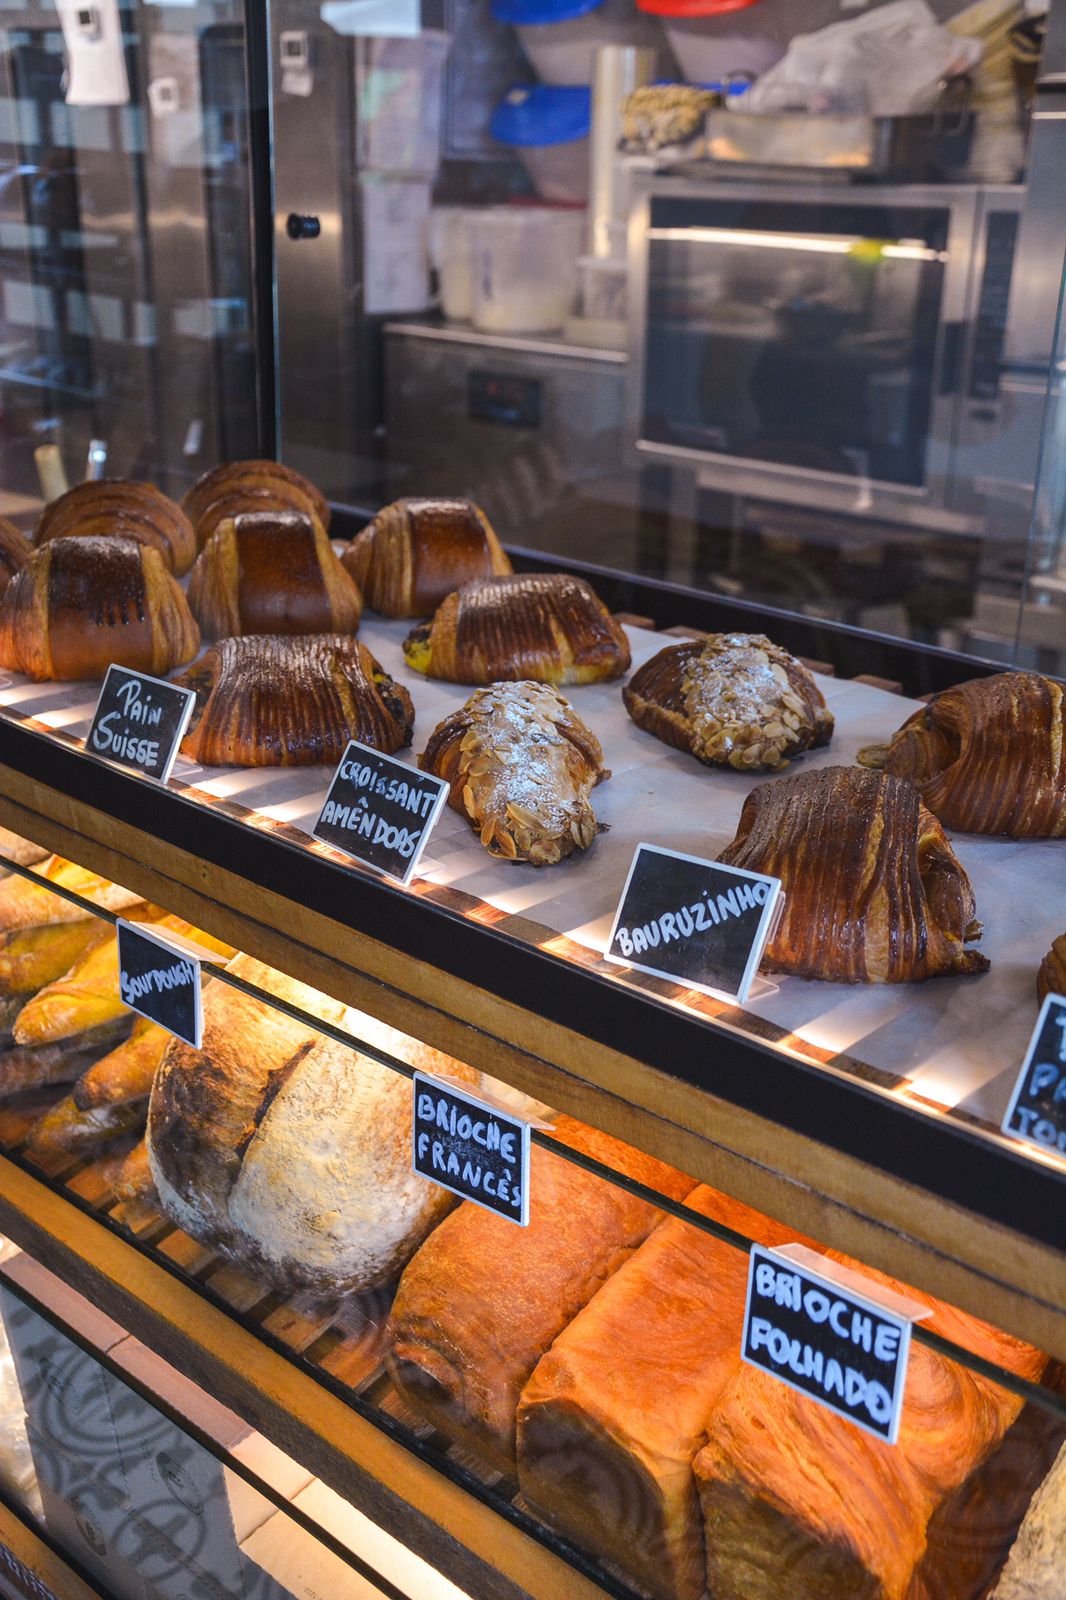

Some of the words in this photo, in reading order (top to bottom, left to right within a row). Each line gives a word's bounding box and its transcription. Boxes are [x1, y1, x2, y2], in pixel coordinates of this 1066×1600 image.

[340, 760, 438, 818] CROISSANT
[615, 881, 771, 957] BAURUZINHO
[418, 1093, 517, 1164] BRIOCHE
[756, 1263, 901, 1362] BRIOCHE
[750, 1316, 892, 1425] FOLHADO
